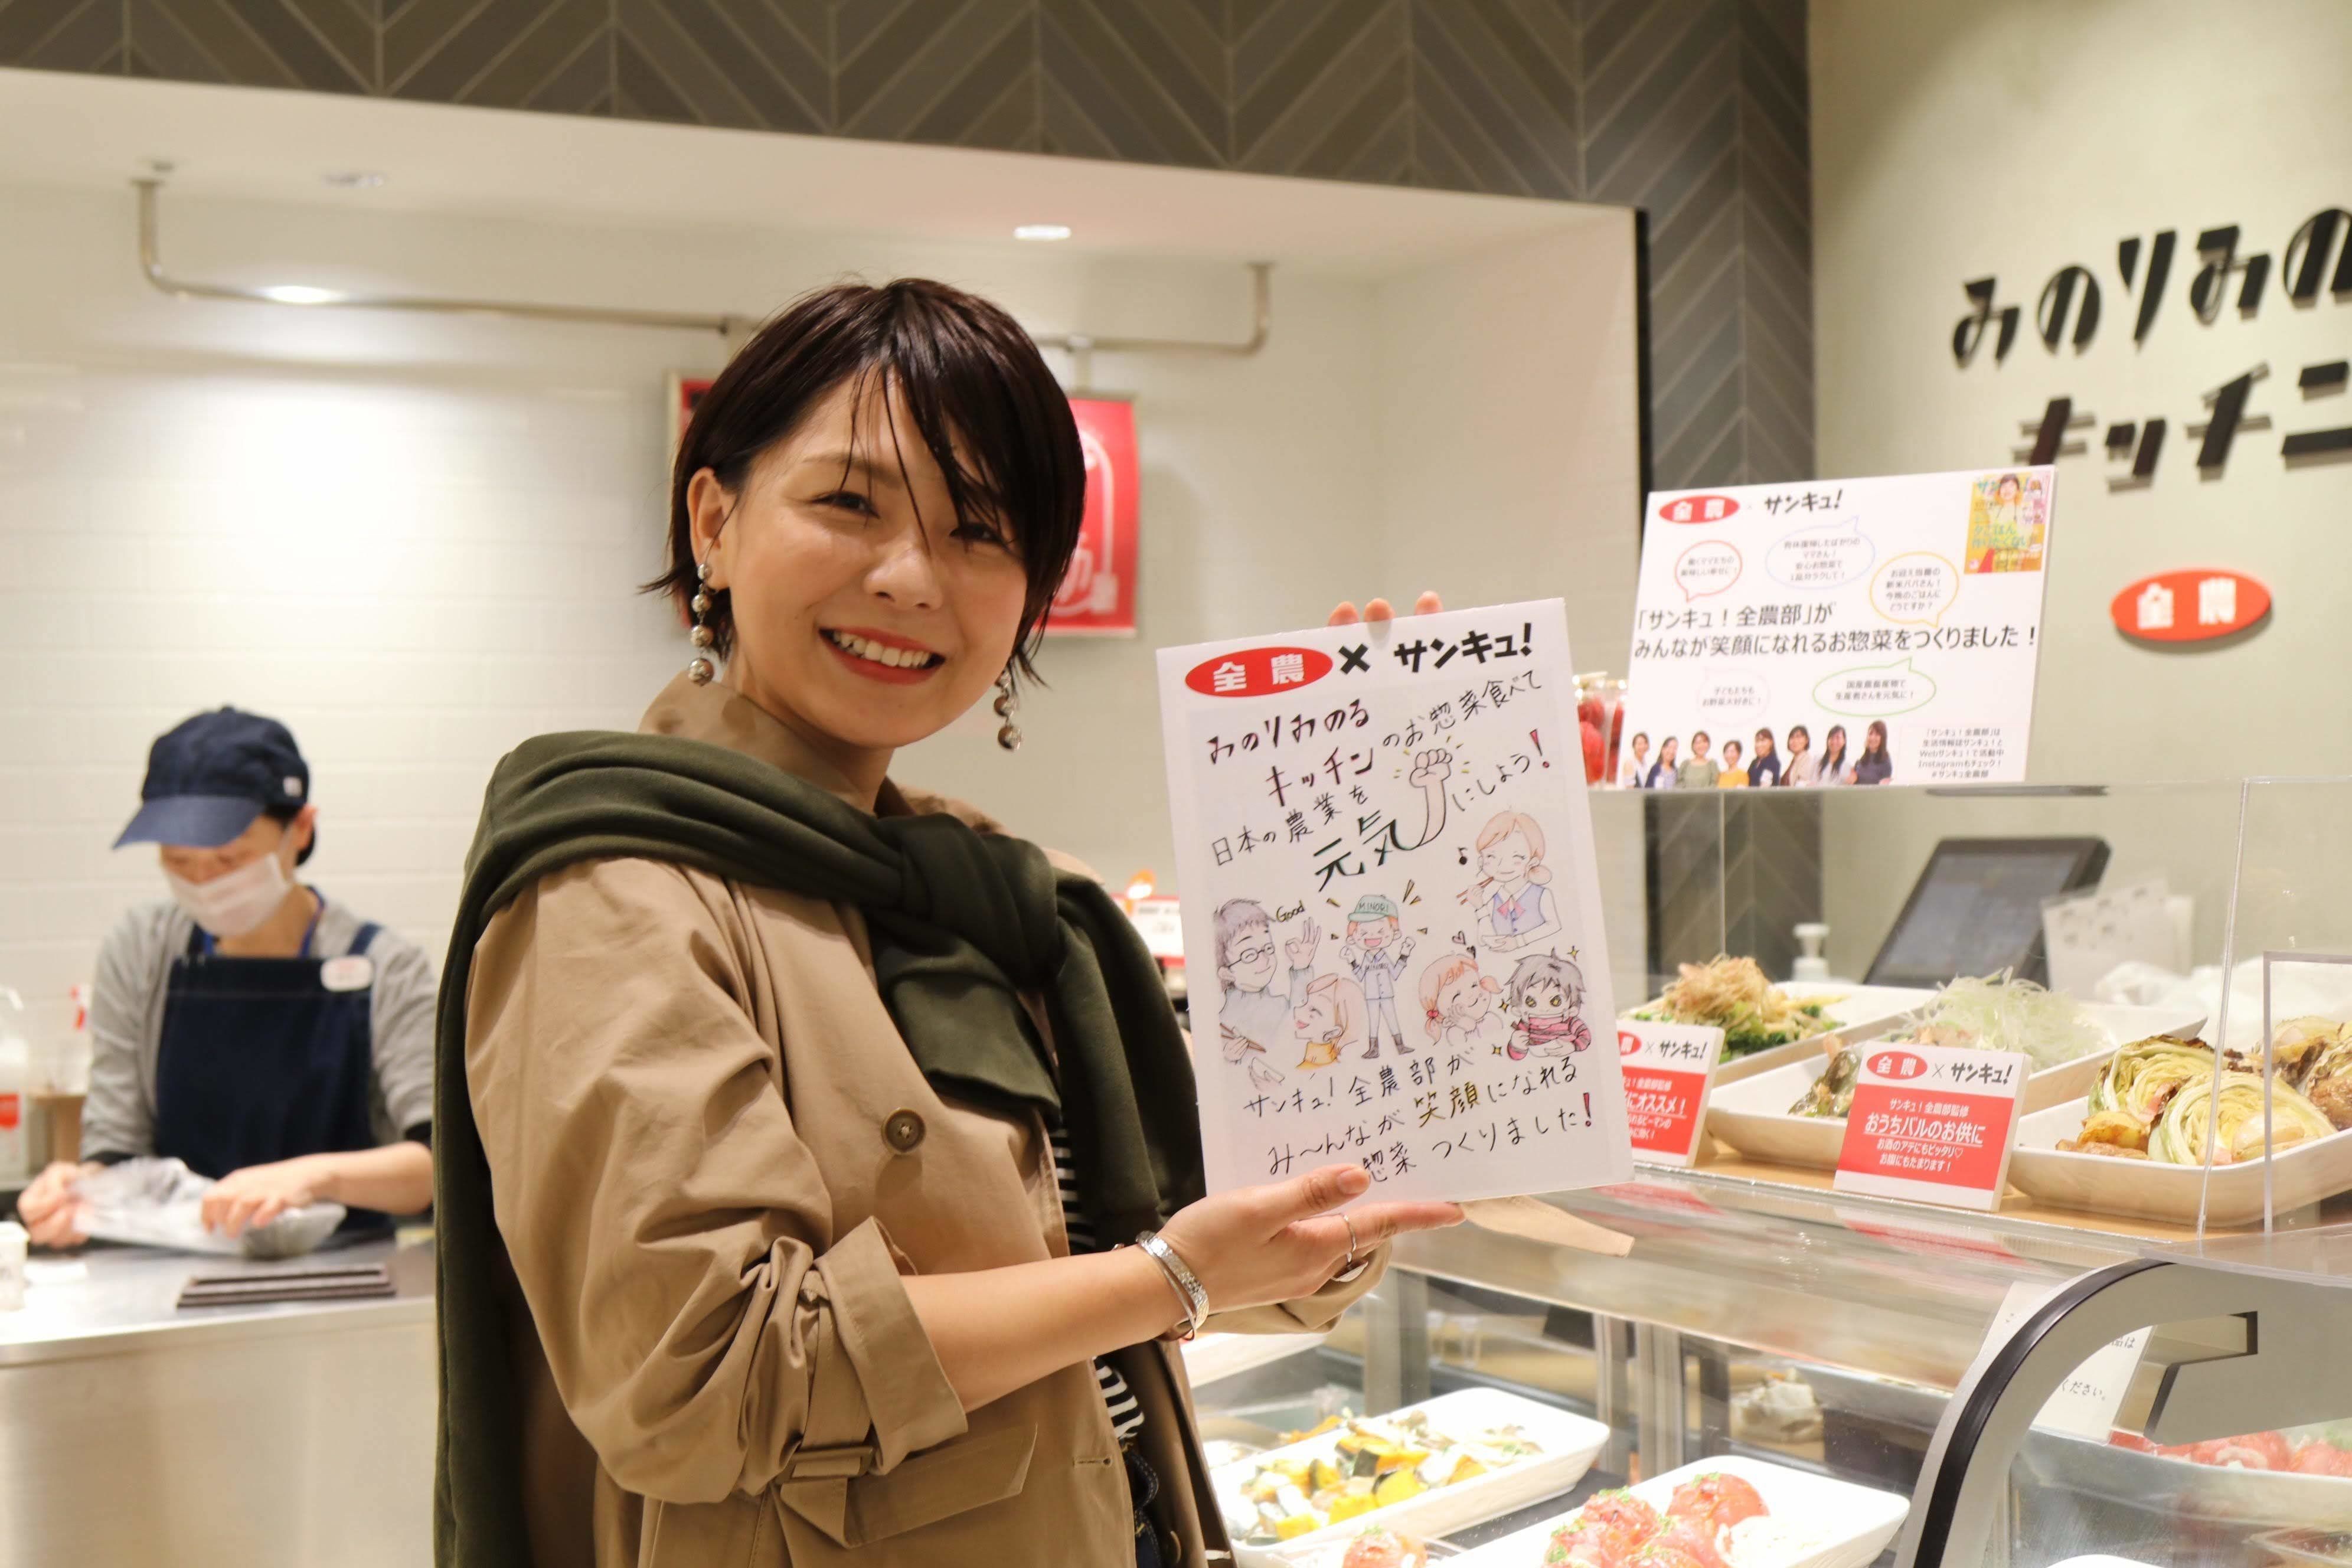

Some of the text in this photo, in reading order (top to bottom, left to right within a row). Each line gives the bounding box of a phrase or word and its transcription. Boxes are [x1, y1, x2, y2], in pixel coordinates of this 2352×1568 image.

[1764, 489, 1843, 515] サンキュ!
[1638, 601, 1838, 630] 「サンキュ！全農部」が
[1634, 626, 2036, 659] みんなが笑顔になれるお惣菜をつくりました！
[1213, 653, 1305, 692] 全農
[1394, 623, 1532, 672] サンキュ!
[1208, 699, 1369, 765] みのりみのる
[1211, 784, 1368, 866] 日本の農業を
[1276, 900, 1305, 922] Good
[1359, 902, 1389, 912] MINORI
[1660, 1040, 1708, 1060] サンキュ!
[1951, 1063, 2013, 1085] サンキュ!
[1865, 1112, 1986, 1144] おうちバルのお供に
